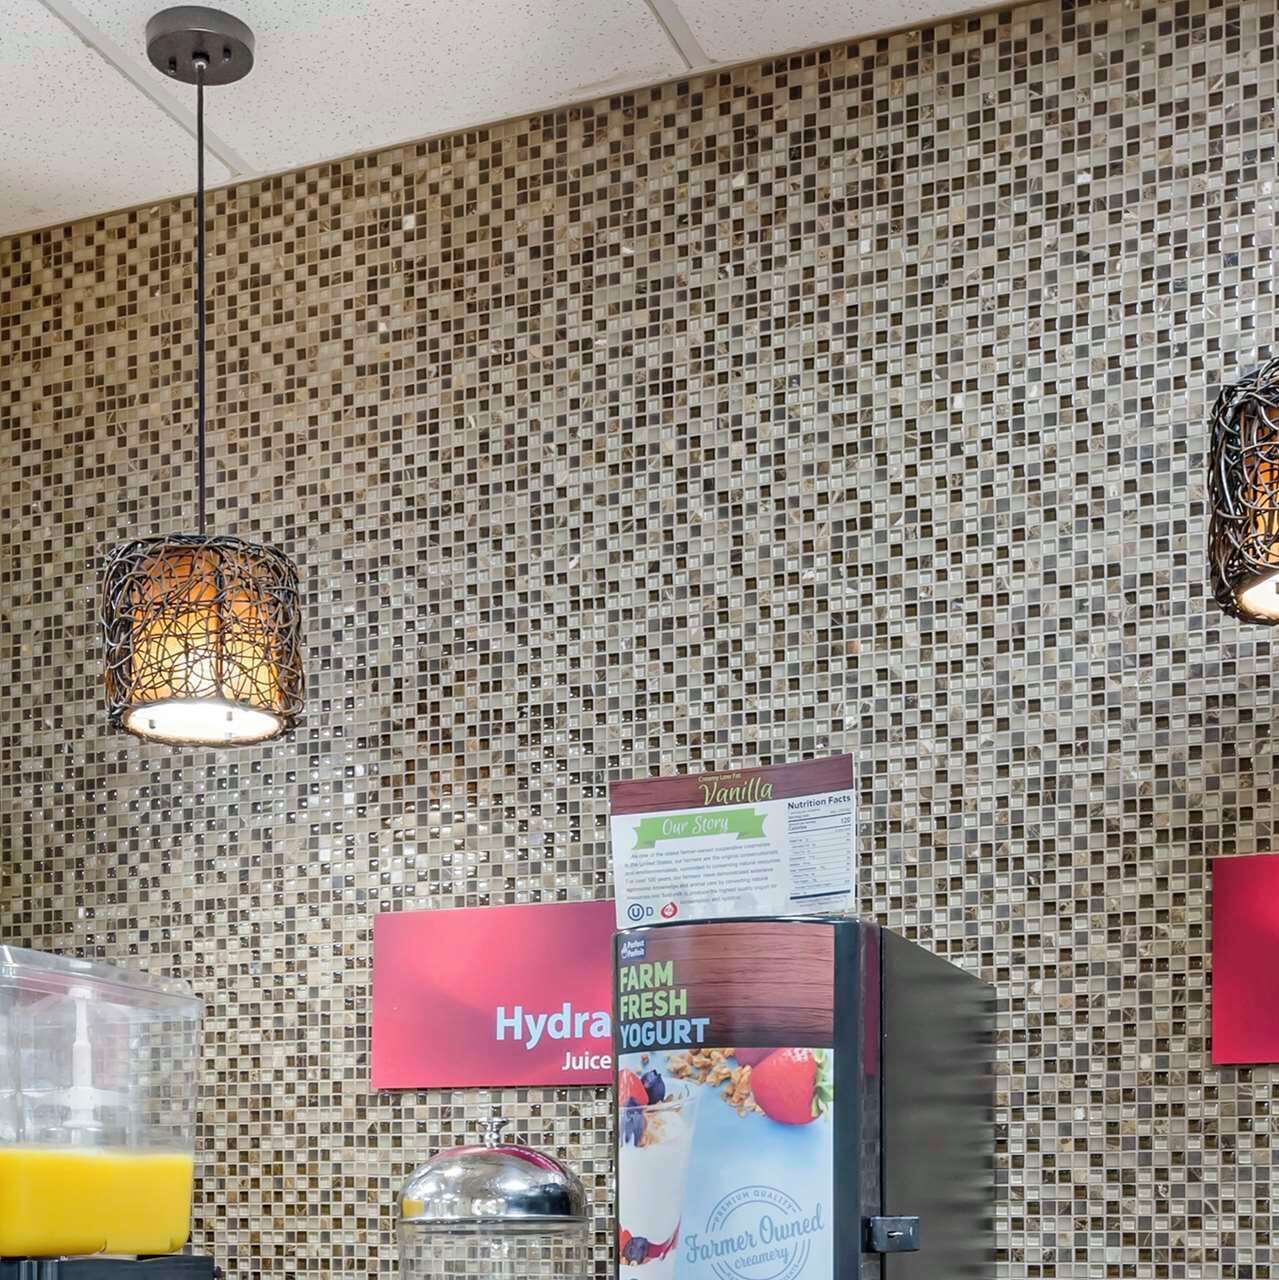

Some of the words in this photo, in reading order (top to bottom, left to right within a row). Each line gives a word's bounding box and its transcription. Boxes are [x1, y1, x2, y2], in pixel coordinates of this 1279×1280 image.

[698, 777, 773, 806] Vanilla
[787, 798, 826, 810] Nutrition
[828, 795, 851, 805] Facts
[662, 817, 688, 835] Our
[692, 815, 728, 835] Story
[646, 906, 654, 917] D
[620, 960, 673, 992] FARM
[620, 989, 687, 1021] FRESH
[620, 1018, 710, 1049] YOGURT
[562, 1052, 612, 1071] Juice
[714, 1191, 750, 1223] PREMIUM
[753, 1189, 793, 1209] QUALITY
[685, 1231, 757, 1263] Farmer
[759, 1202, 824, 1244] Owned
[734, 1247, 788, 1270] creamery
